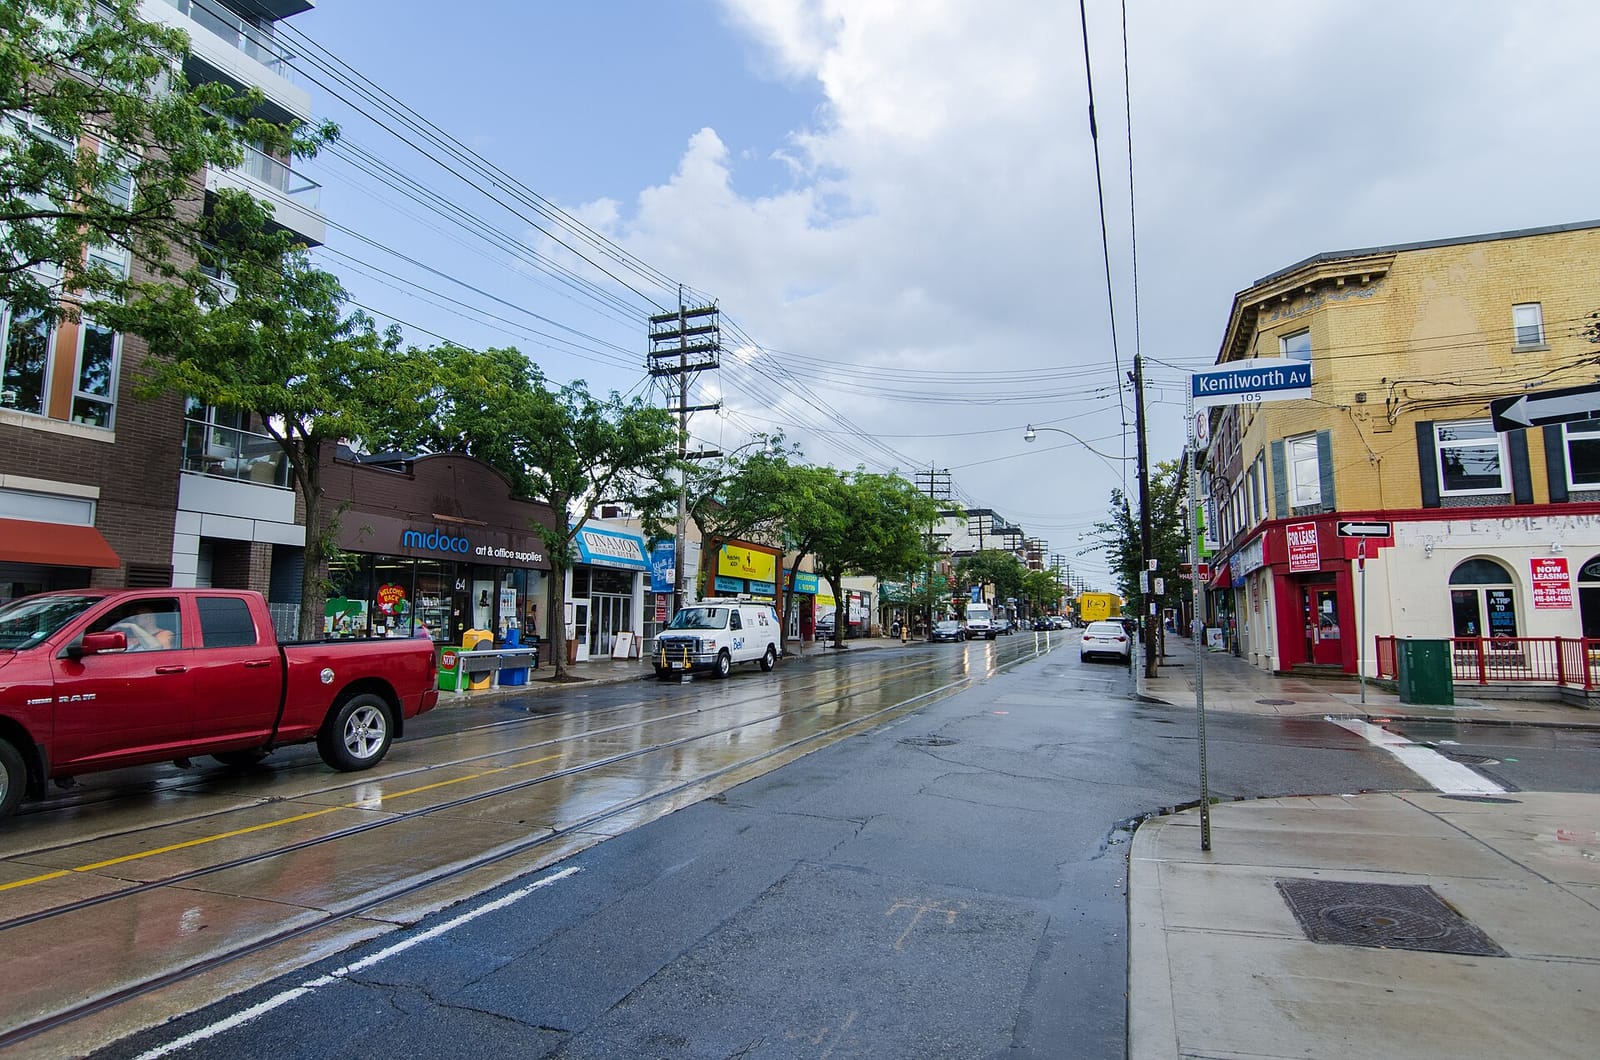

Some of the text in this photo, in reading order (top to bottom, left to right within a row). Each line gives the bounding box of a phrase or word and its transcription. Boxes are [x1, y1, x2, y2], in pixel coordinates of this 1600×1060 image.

[1200, 370, 1307, 392] Kenilworth Av
[1241, 393, 1262, 402] 105
[403, 528, 469, 553] midoco
[585, 532, 640, 553] CINAMON
[1288, 530, 1316, 546] FOR LEASE
[475, 546, 542, 562] art & office supplies
[1533, 572, 1569, 580] LEASING
[455, 578, 466, 591] 64
[380, 587, 403, 597] WELCOME
[384, 594, 399, 602] BACK
[1495, 597, 1511, 605] TRIP
[733, 637, 742, 651] Bell
[442, 654, 456, 665] NOW
[59, 693, 97, 703] RAM
